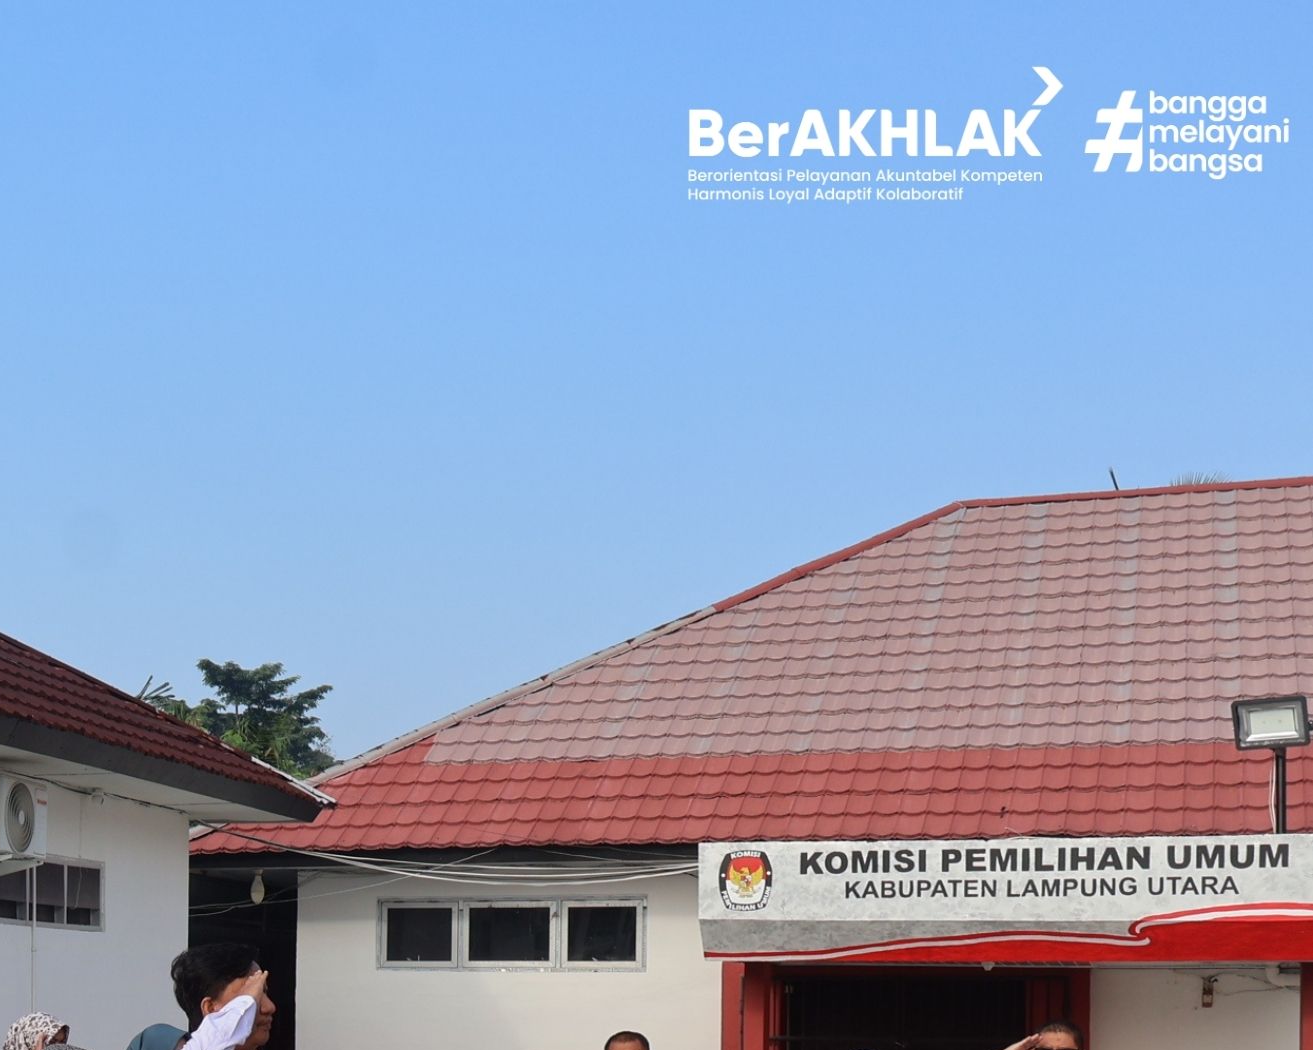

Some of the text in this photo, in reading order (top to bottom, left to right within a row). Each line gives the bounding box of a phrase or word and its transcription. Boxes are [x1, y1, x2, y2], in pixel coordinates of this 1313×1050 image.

[799, 843, 1291, 876] KOMISI PEMILIHAN UMUM
[844, 875, 1240, 900] KABUPATEN LAMPUNG UTARA
